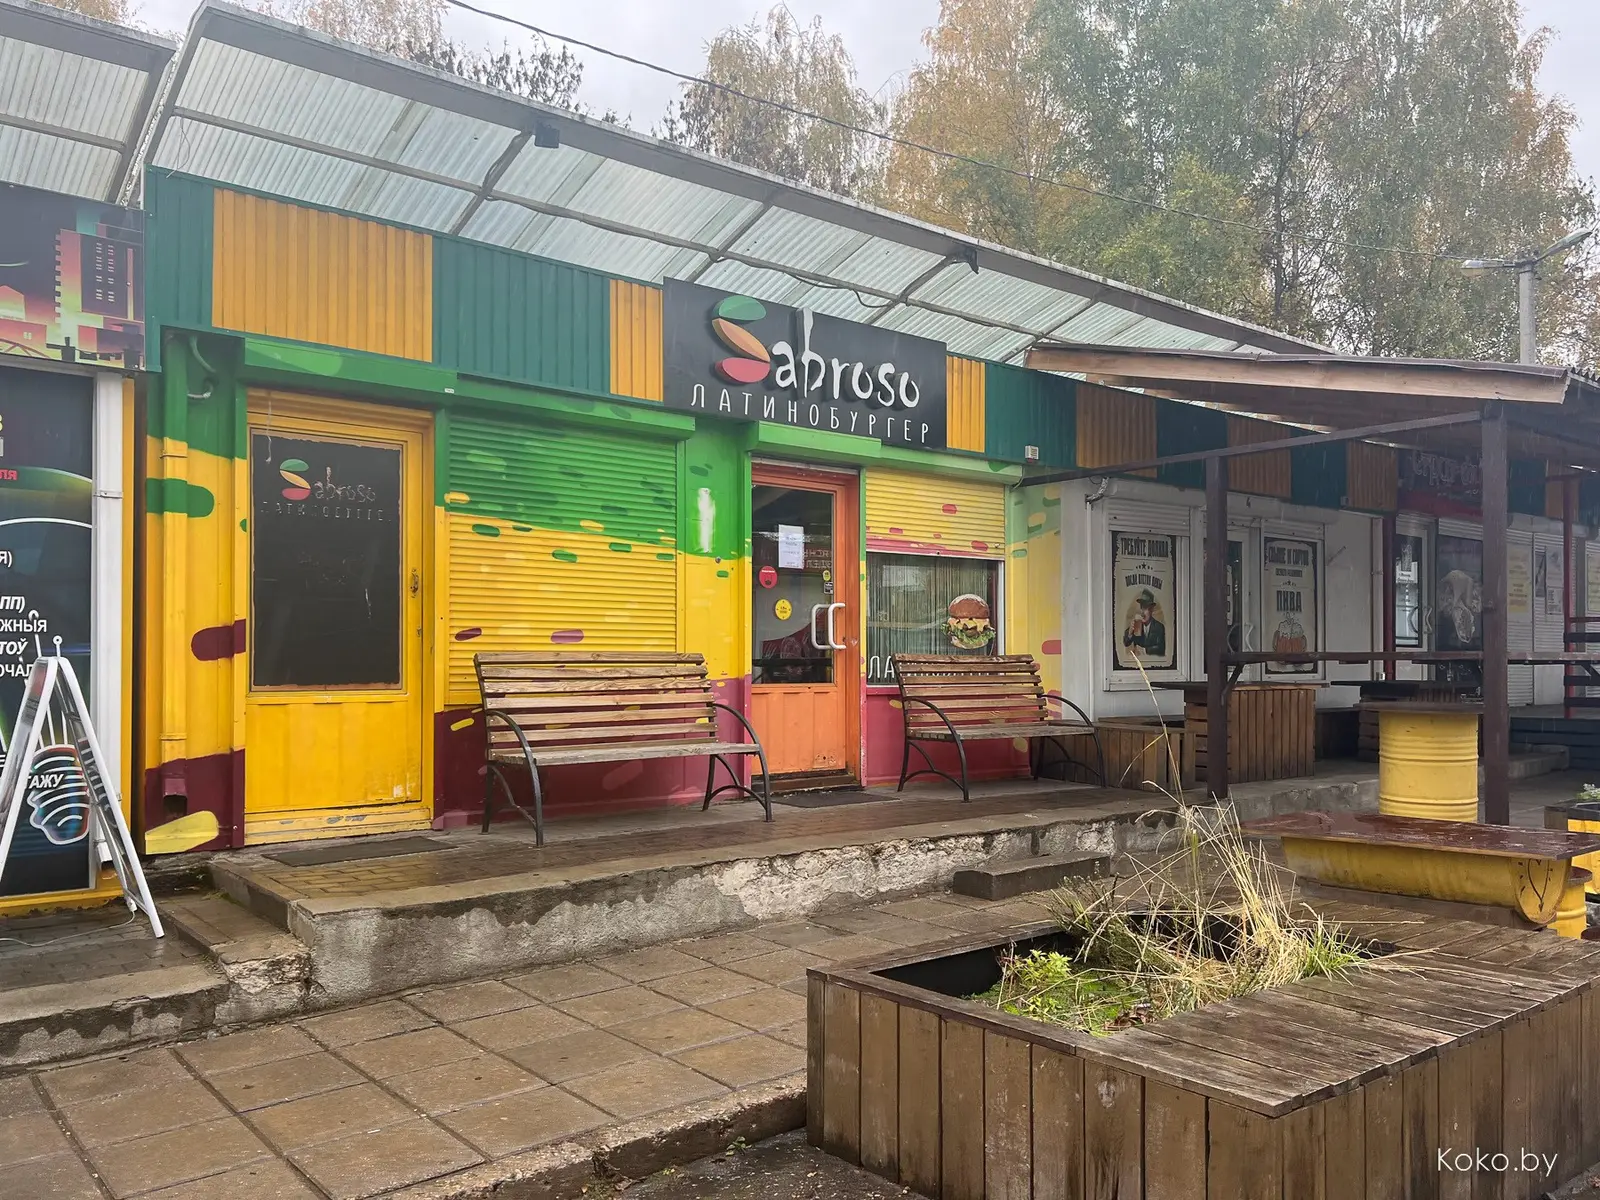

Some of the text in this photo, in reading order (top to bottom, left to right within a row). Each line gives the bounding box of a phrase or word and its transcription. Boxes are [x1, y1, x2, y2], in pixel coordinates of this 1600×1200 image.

[711, 295, 920, 408] Sabroso
[691, 383, 929, 443] ЛАТИНОБУРГЕР
[1276, 589, 1302, 613] ПИВА
